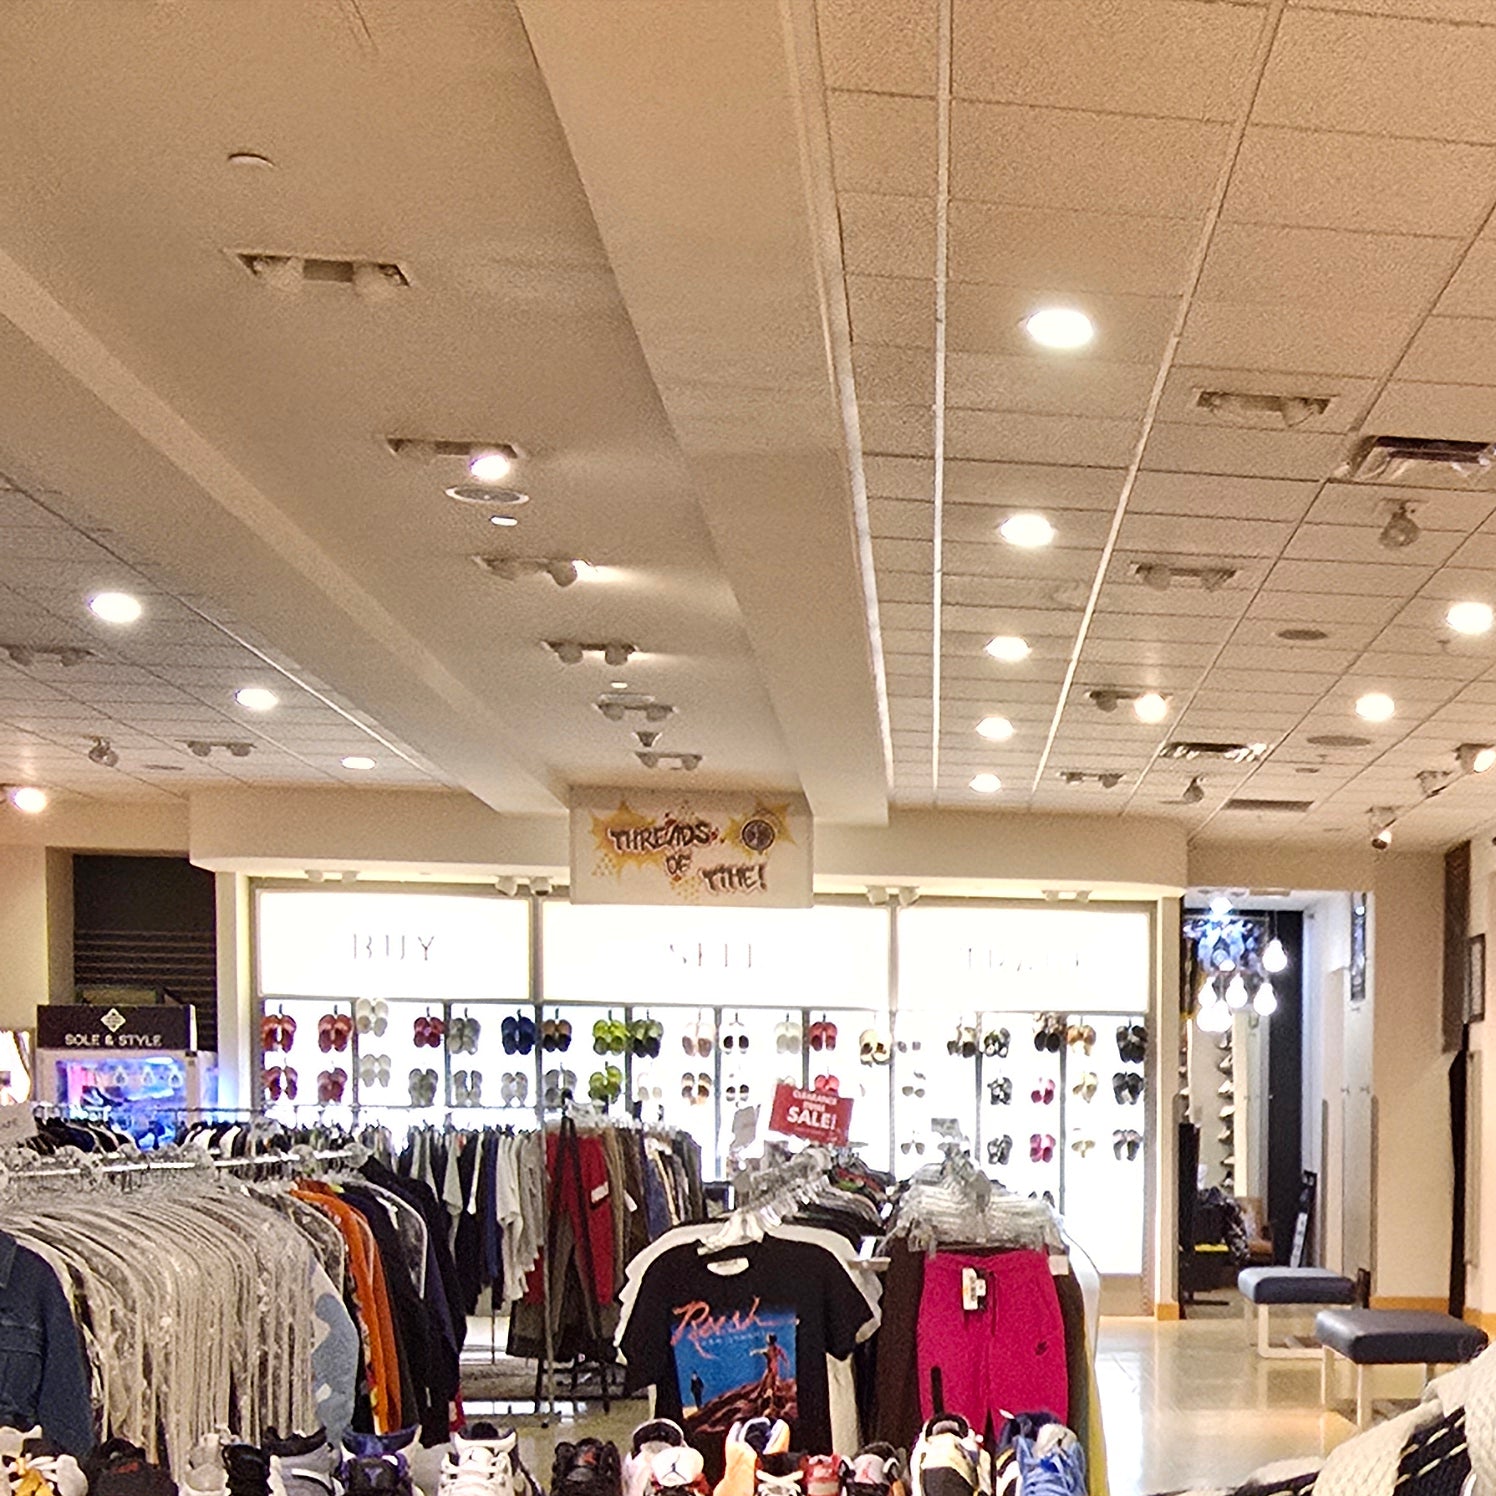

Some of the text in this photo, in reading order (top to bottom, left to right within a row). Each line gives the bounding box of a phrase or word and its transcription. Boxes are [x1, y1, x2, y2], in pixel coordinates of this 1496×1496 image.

[609, 819, 716, 852] THREADS
[665, 852, 692, 875] OF
[64, 1033, 162, 1047] SOLE & STYLE
[786, 1105, 837, 1130] SALE!
